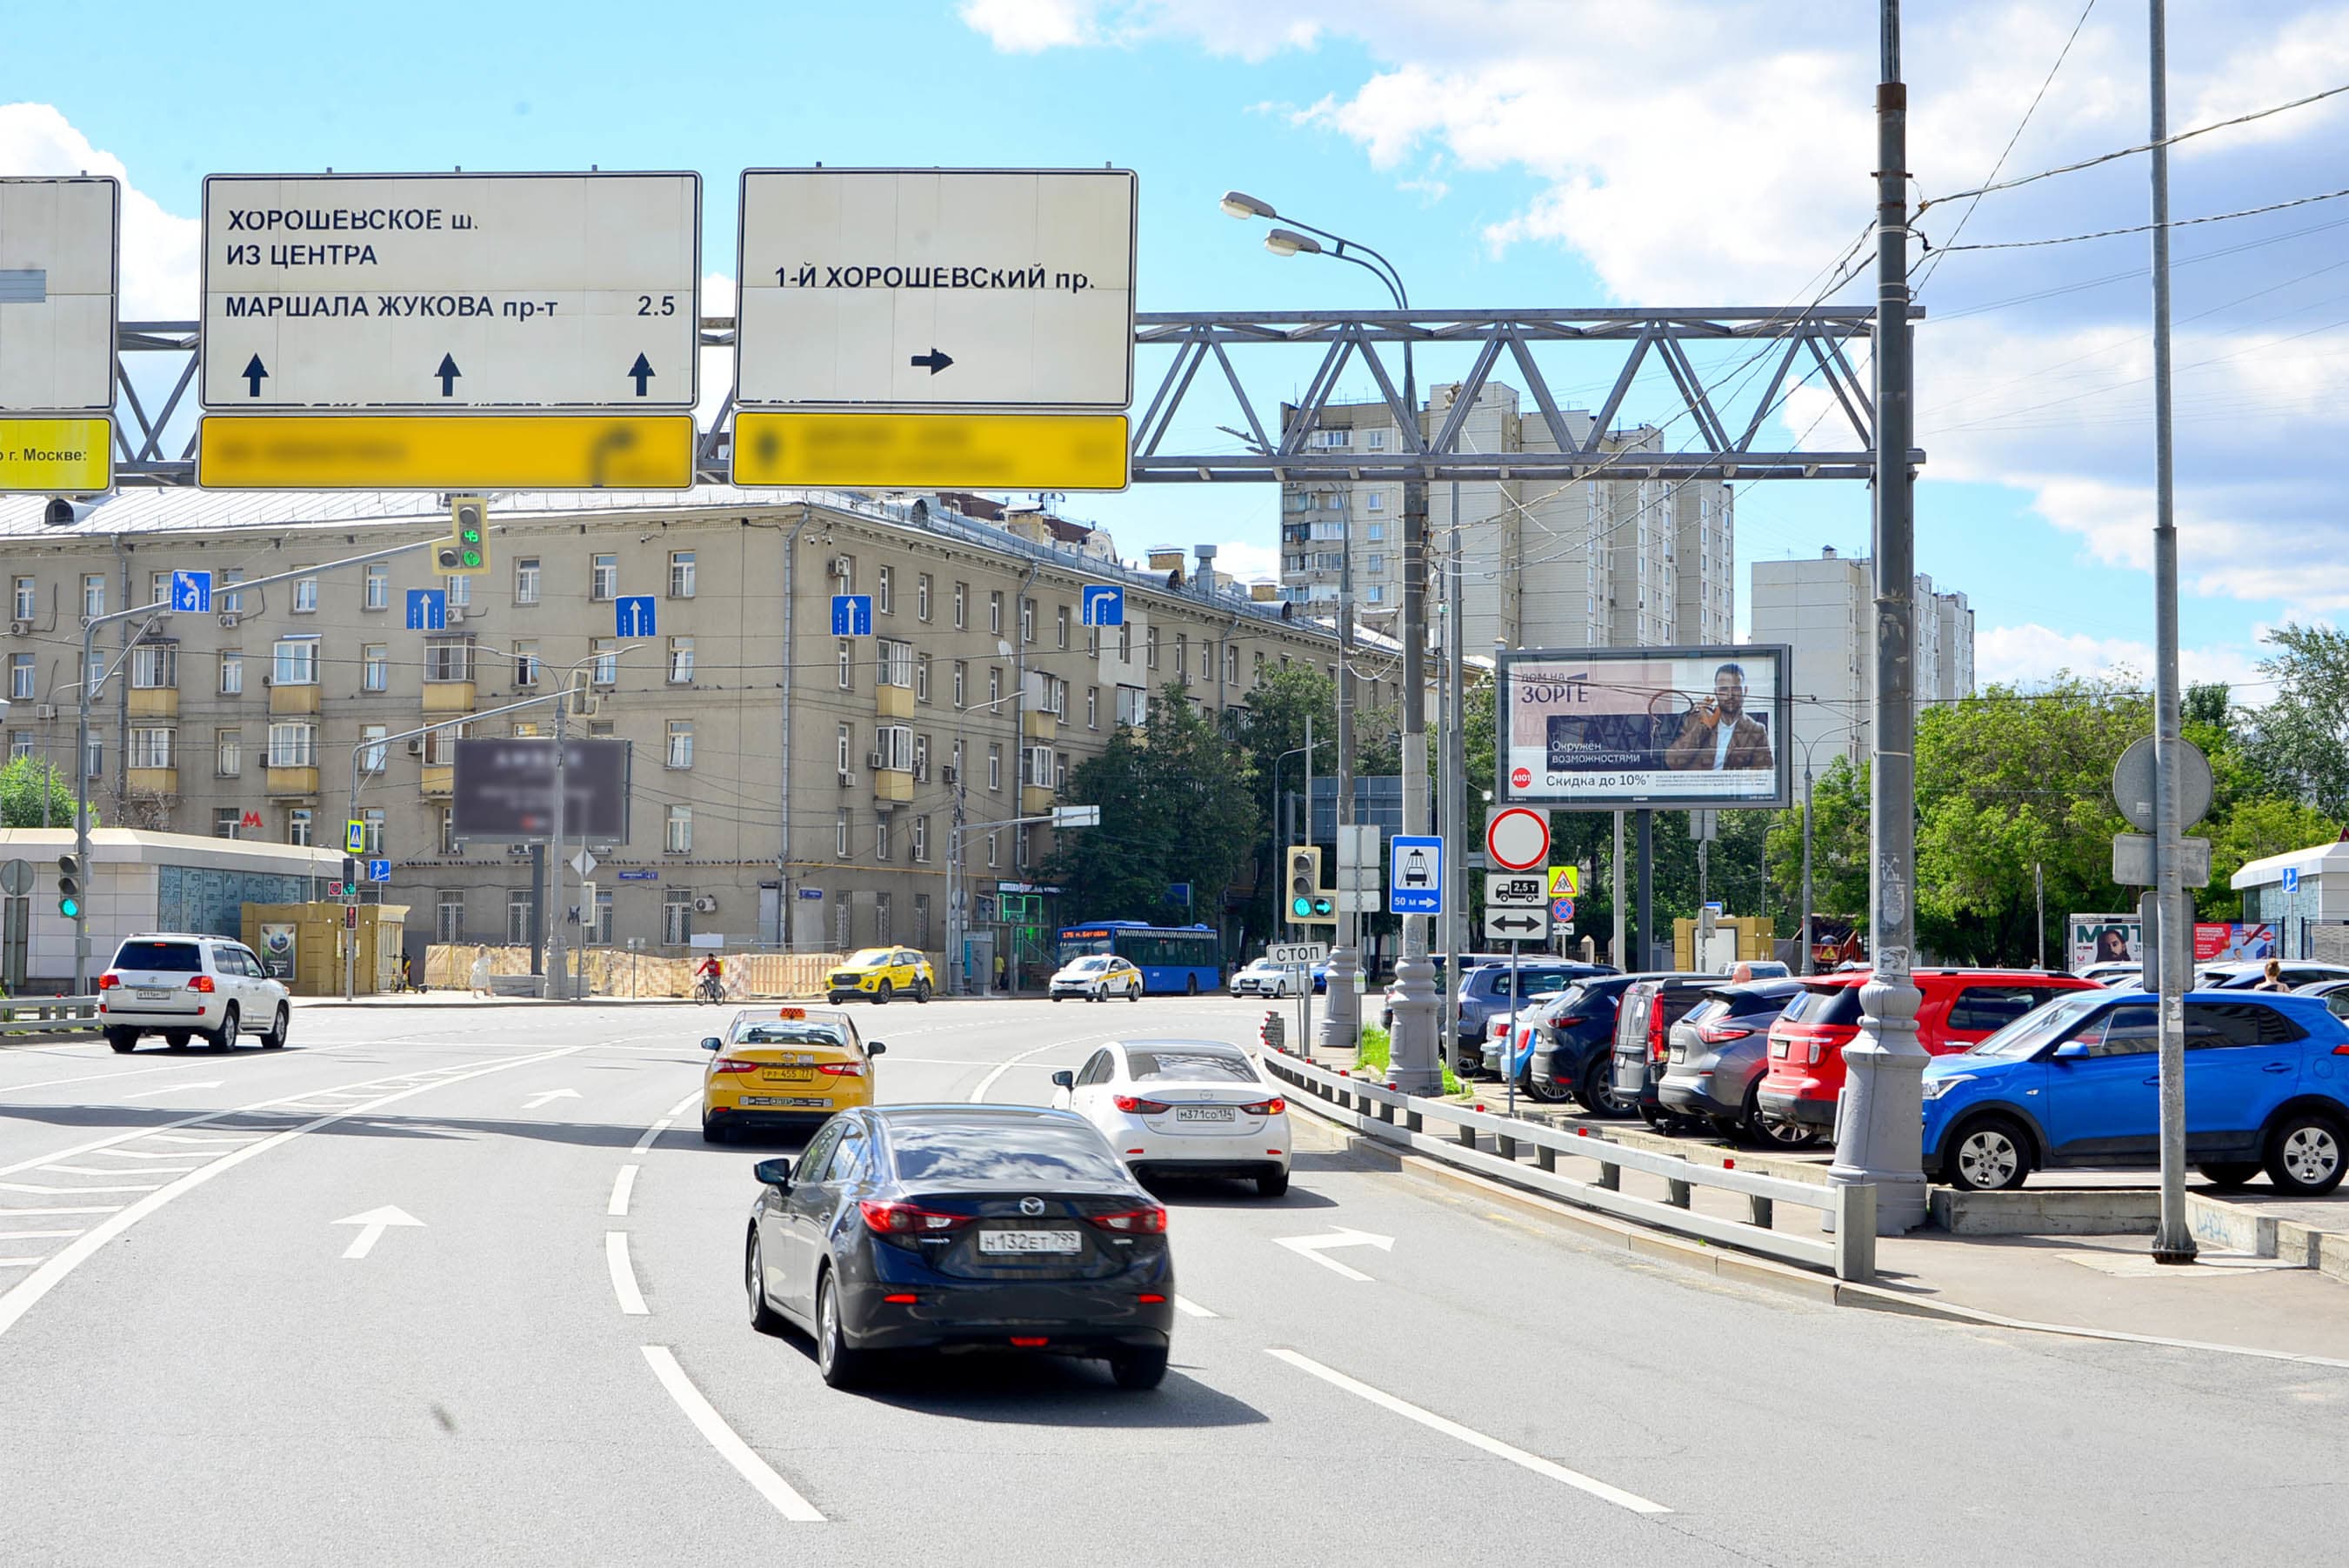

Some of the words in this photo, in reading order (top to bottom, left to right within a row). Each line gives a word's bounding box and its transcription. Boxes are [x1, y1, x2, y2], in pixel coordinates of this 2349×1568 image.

[228, 209, 443, 230] ХОРОШЕВСКОЕ
[451, 214, 479, 230] ш.
[227, 244, 262, 265] ИЗ
[270, 244, 378, 270] ЦЕНТРА
[775, 261, 817, 288] 1-Й
[825, 262, 1045, 289] ХОРОШЕВСКИЙ
[1056, 272, 1095, 294] пр.
[226, 296, 370, 317] МАРШАЛА
[377, 296, 495, 317] ЖУКОВА
[503, 301, 558, 322] пр-т
[637, 295, 675, 316] 2.5
[9, 451, 19, 461] г.
[23, 447, 87, 462] Москве:
[1522, 684, 1589, 704] ЗОРГЕ
[1552, 754, 1640, 764] возможностями
[1546, 776, 1595, 788] Скидка
[1598, 777, 1616, 788] до
[1513, 882, 1529, 892] 2,5
[1394, 897, 1406, 905] 50
[1277, 946, 1319, 962] СТОП
